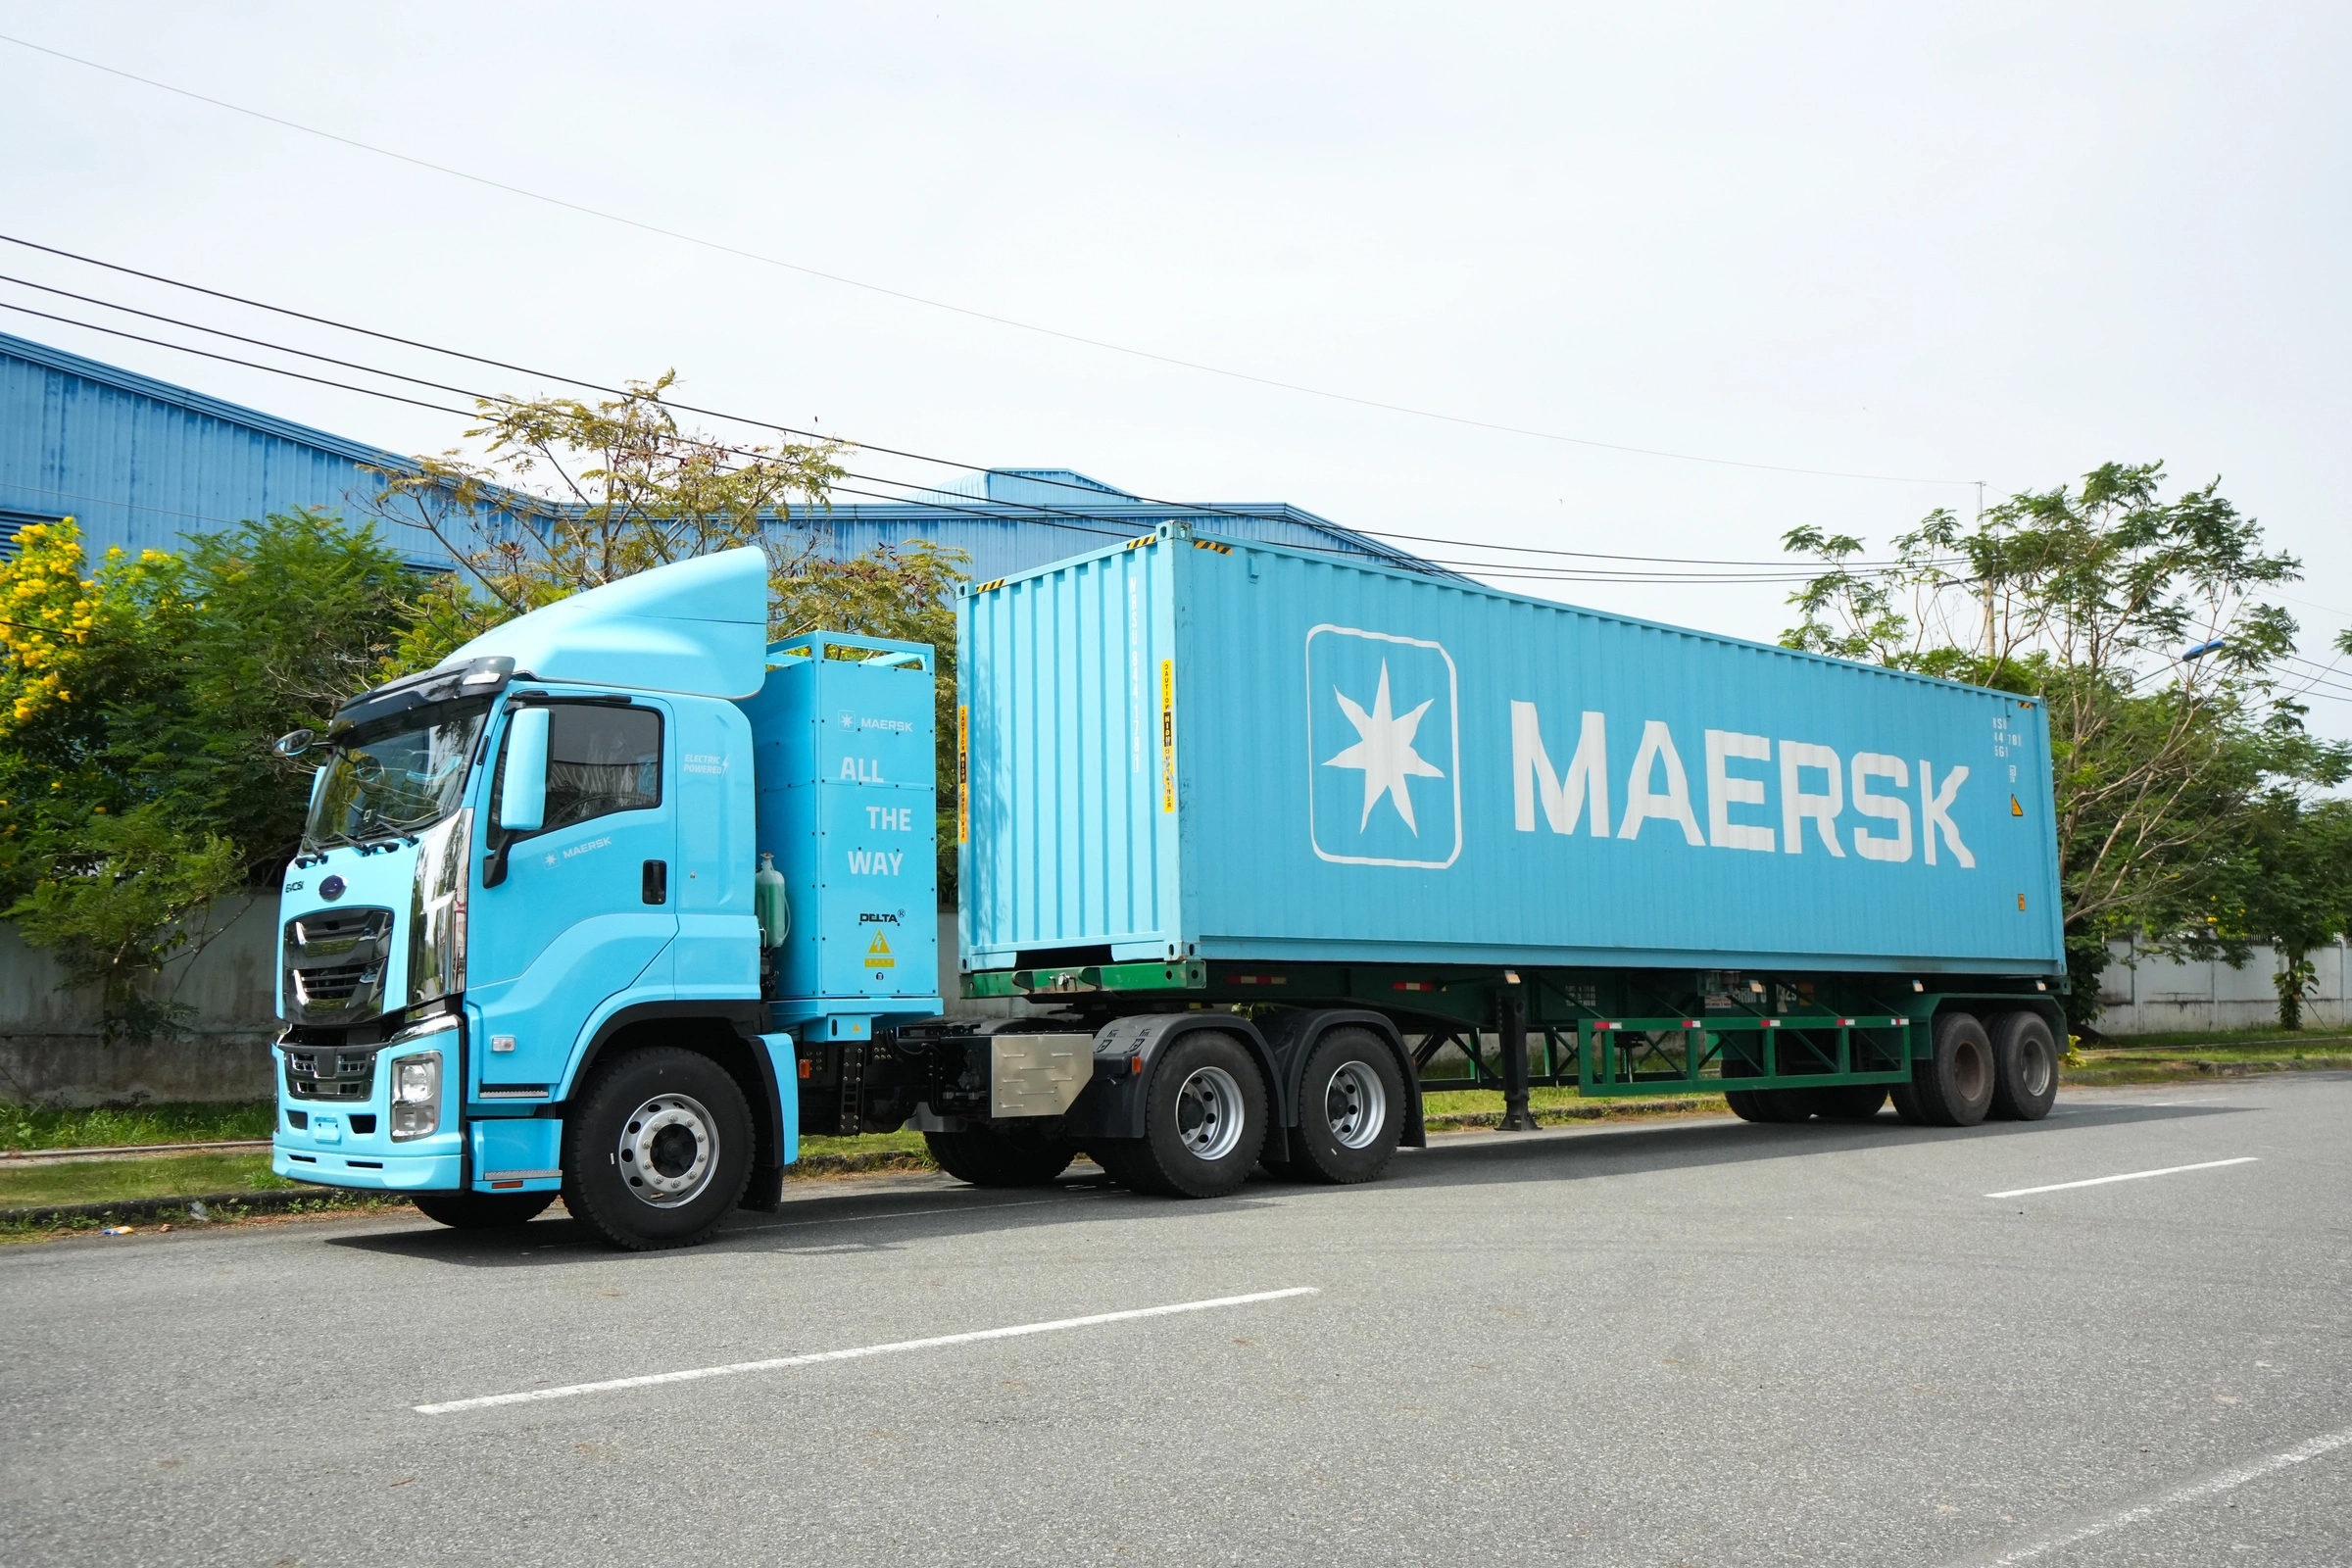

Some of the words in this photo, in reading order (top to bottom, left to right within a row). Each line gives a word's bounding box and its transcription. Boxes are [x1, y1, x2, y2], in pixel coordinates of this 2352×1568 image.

[860, 717, 913, 733] MAERSK
[683, 763, 723, 774] POWERED
[684, 754, 721, 764] ELECTRIC
[840, 757, 885, 783] ALL
[1510, 699, 1976, 869] MAERSK
[865, 806, 912, 832] THE
[563, 836, 612, 859] MAERSK
[848, 851, 905, 876] WAY
